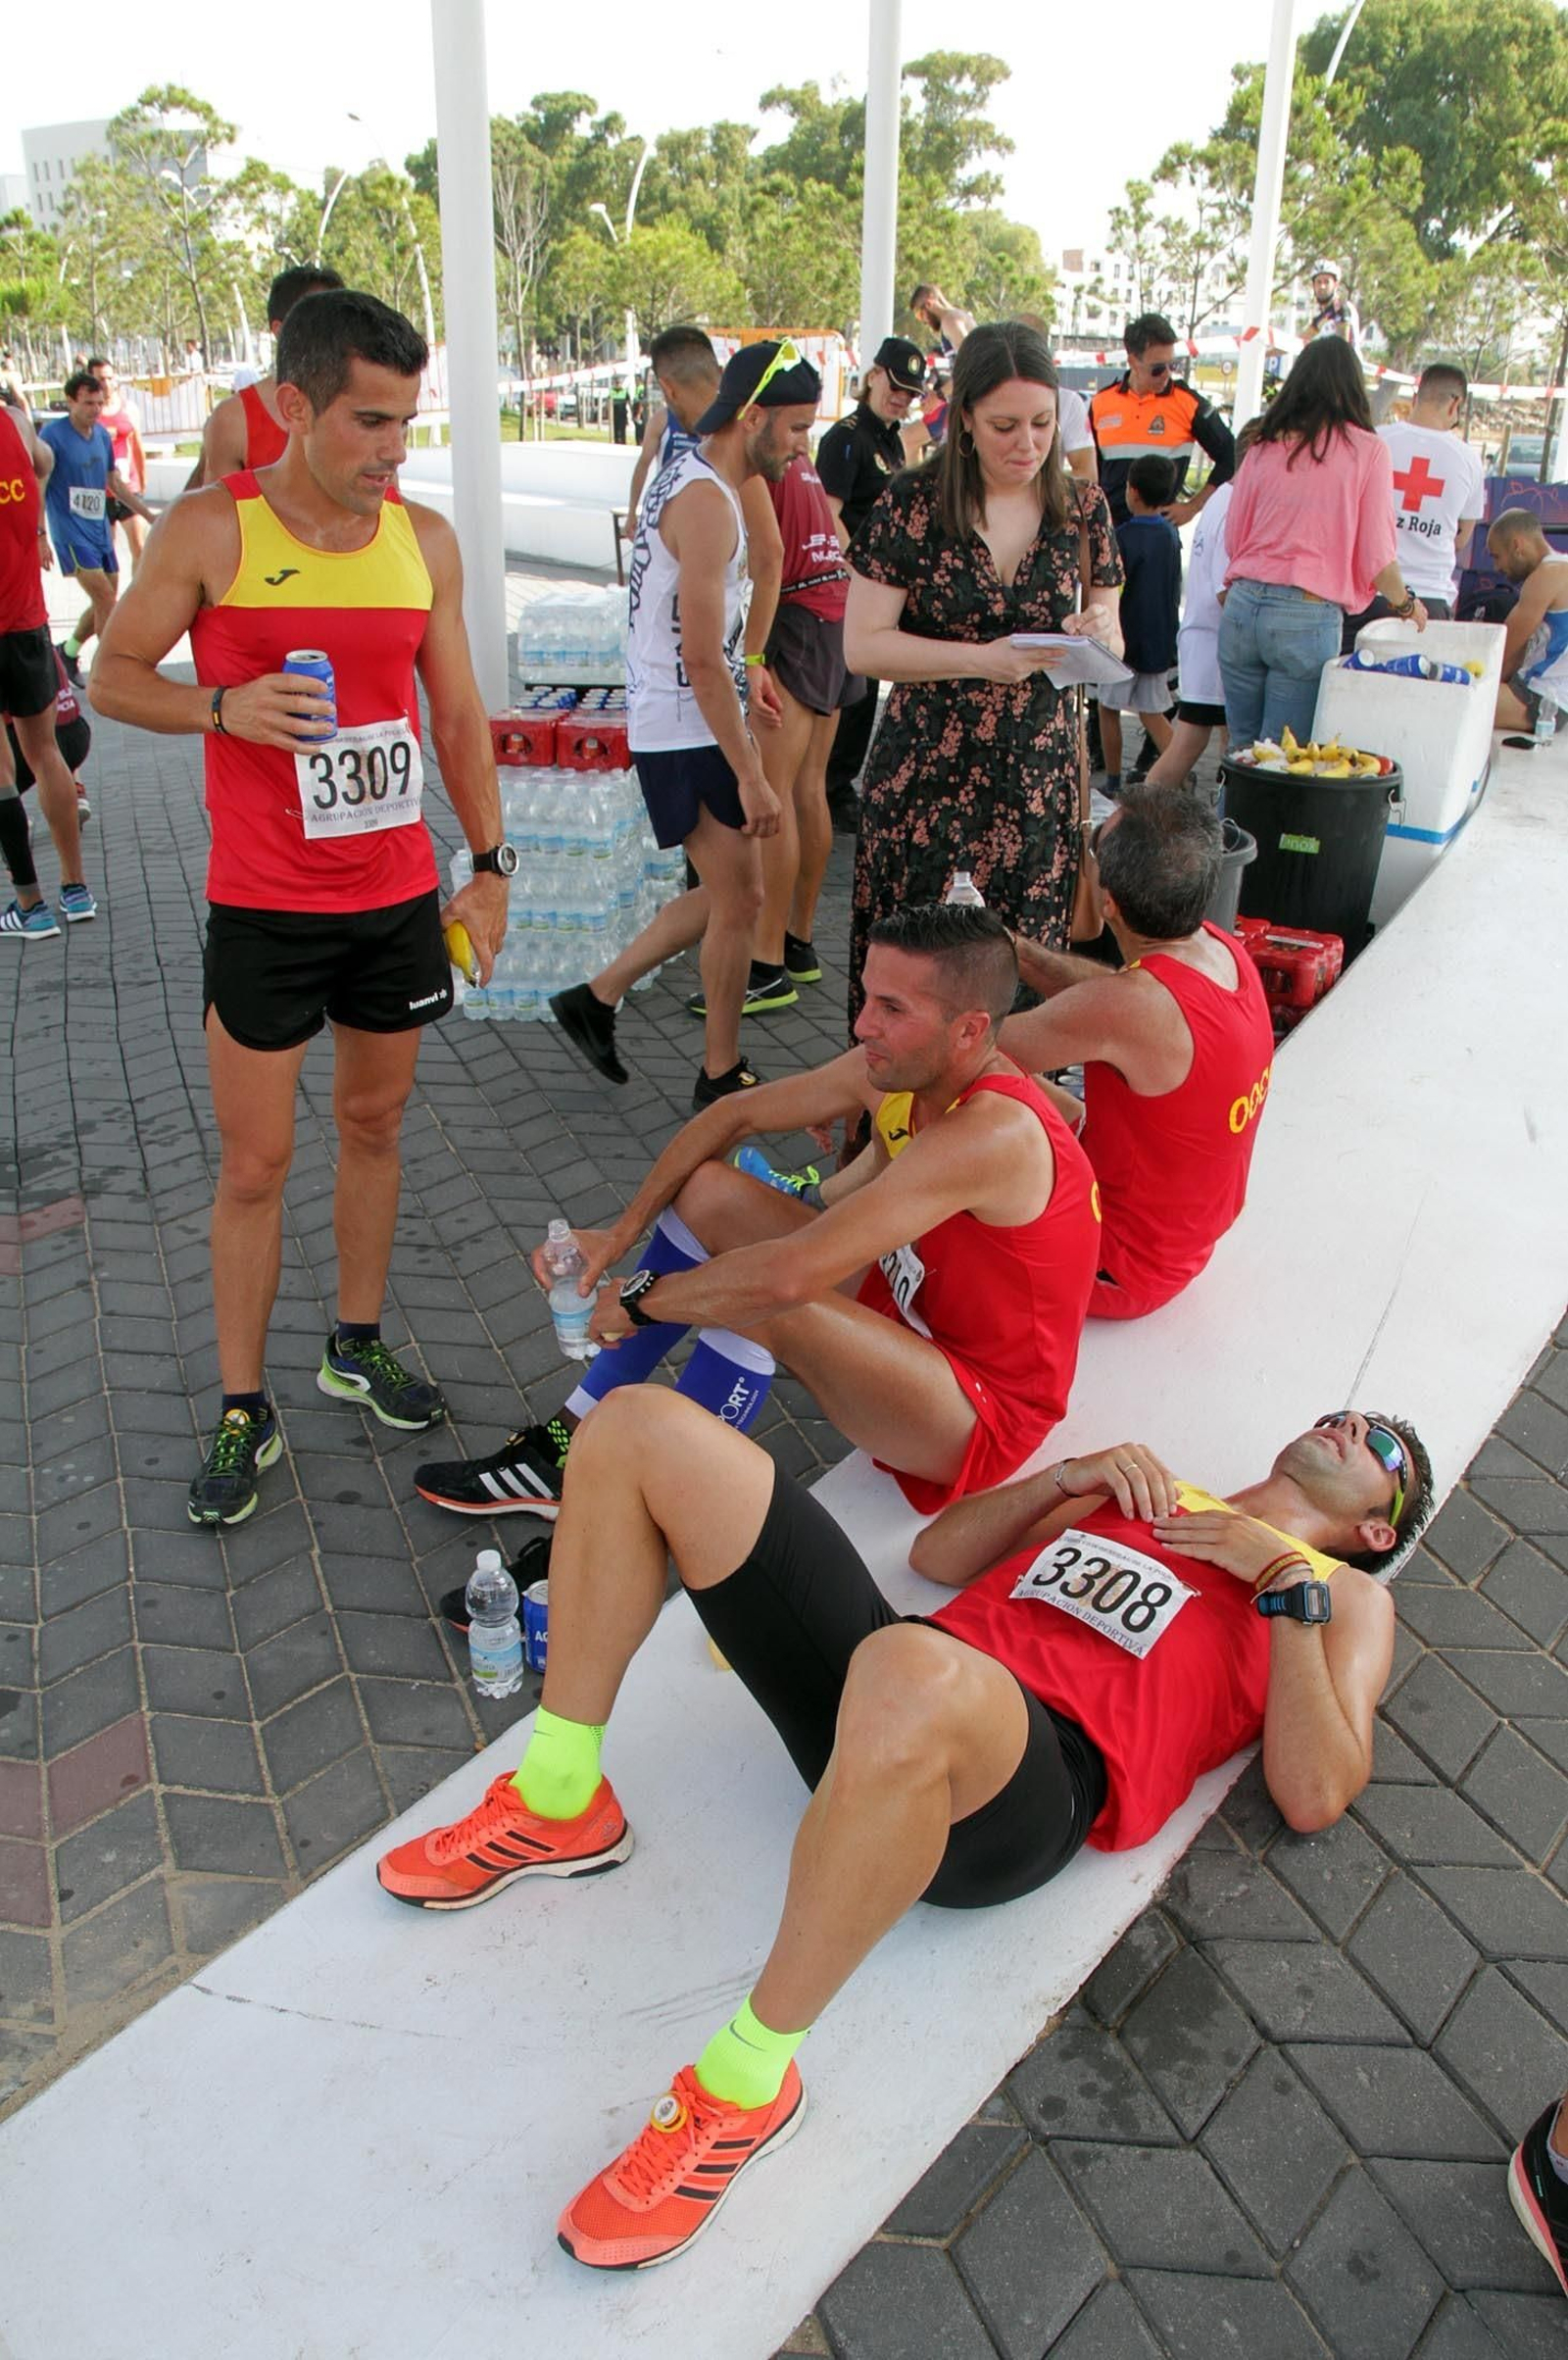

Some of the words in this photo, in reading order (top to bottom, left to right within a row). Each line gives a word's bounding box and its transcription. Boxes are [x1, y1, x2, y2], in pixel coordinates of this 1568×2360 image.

[1408, 516, 1443, 538] Roja
[309, 741, 412, 811] 3309
[1018, 1588, 1082, 1616] AGRUPACIÓN
[1082, 1609, 1145, 1657] DEPORTIVA
[1032, 1547, 1173, 1634] 3308
